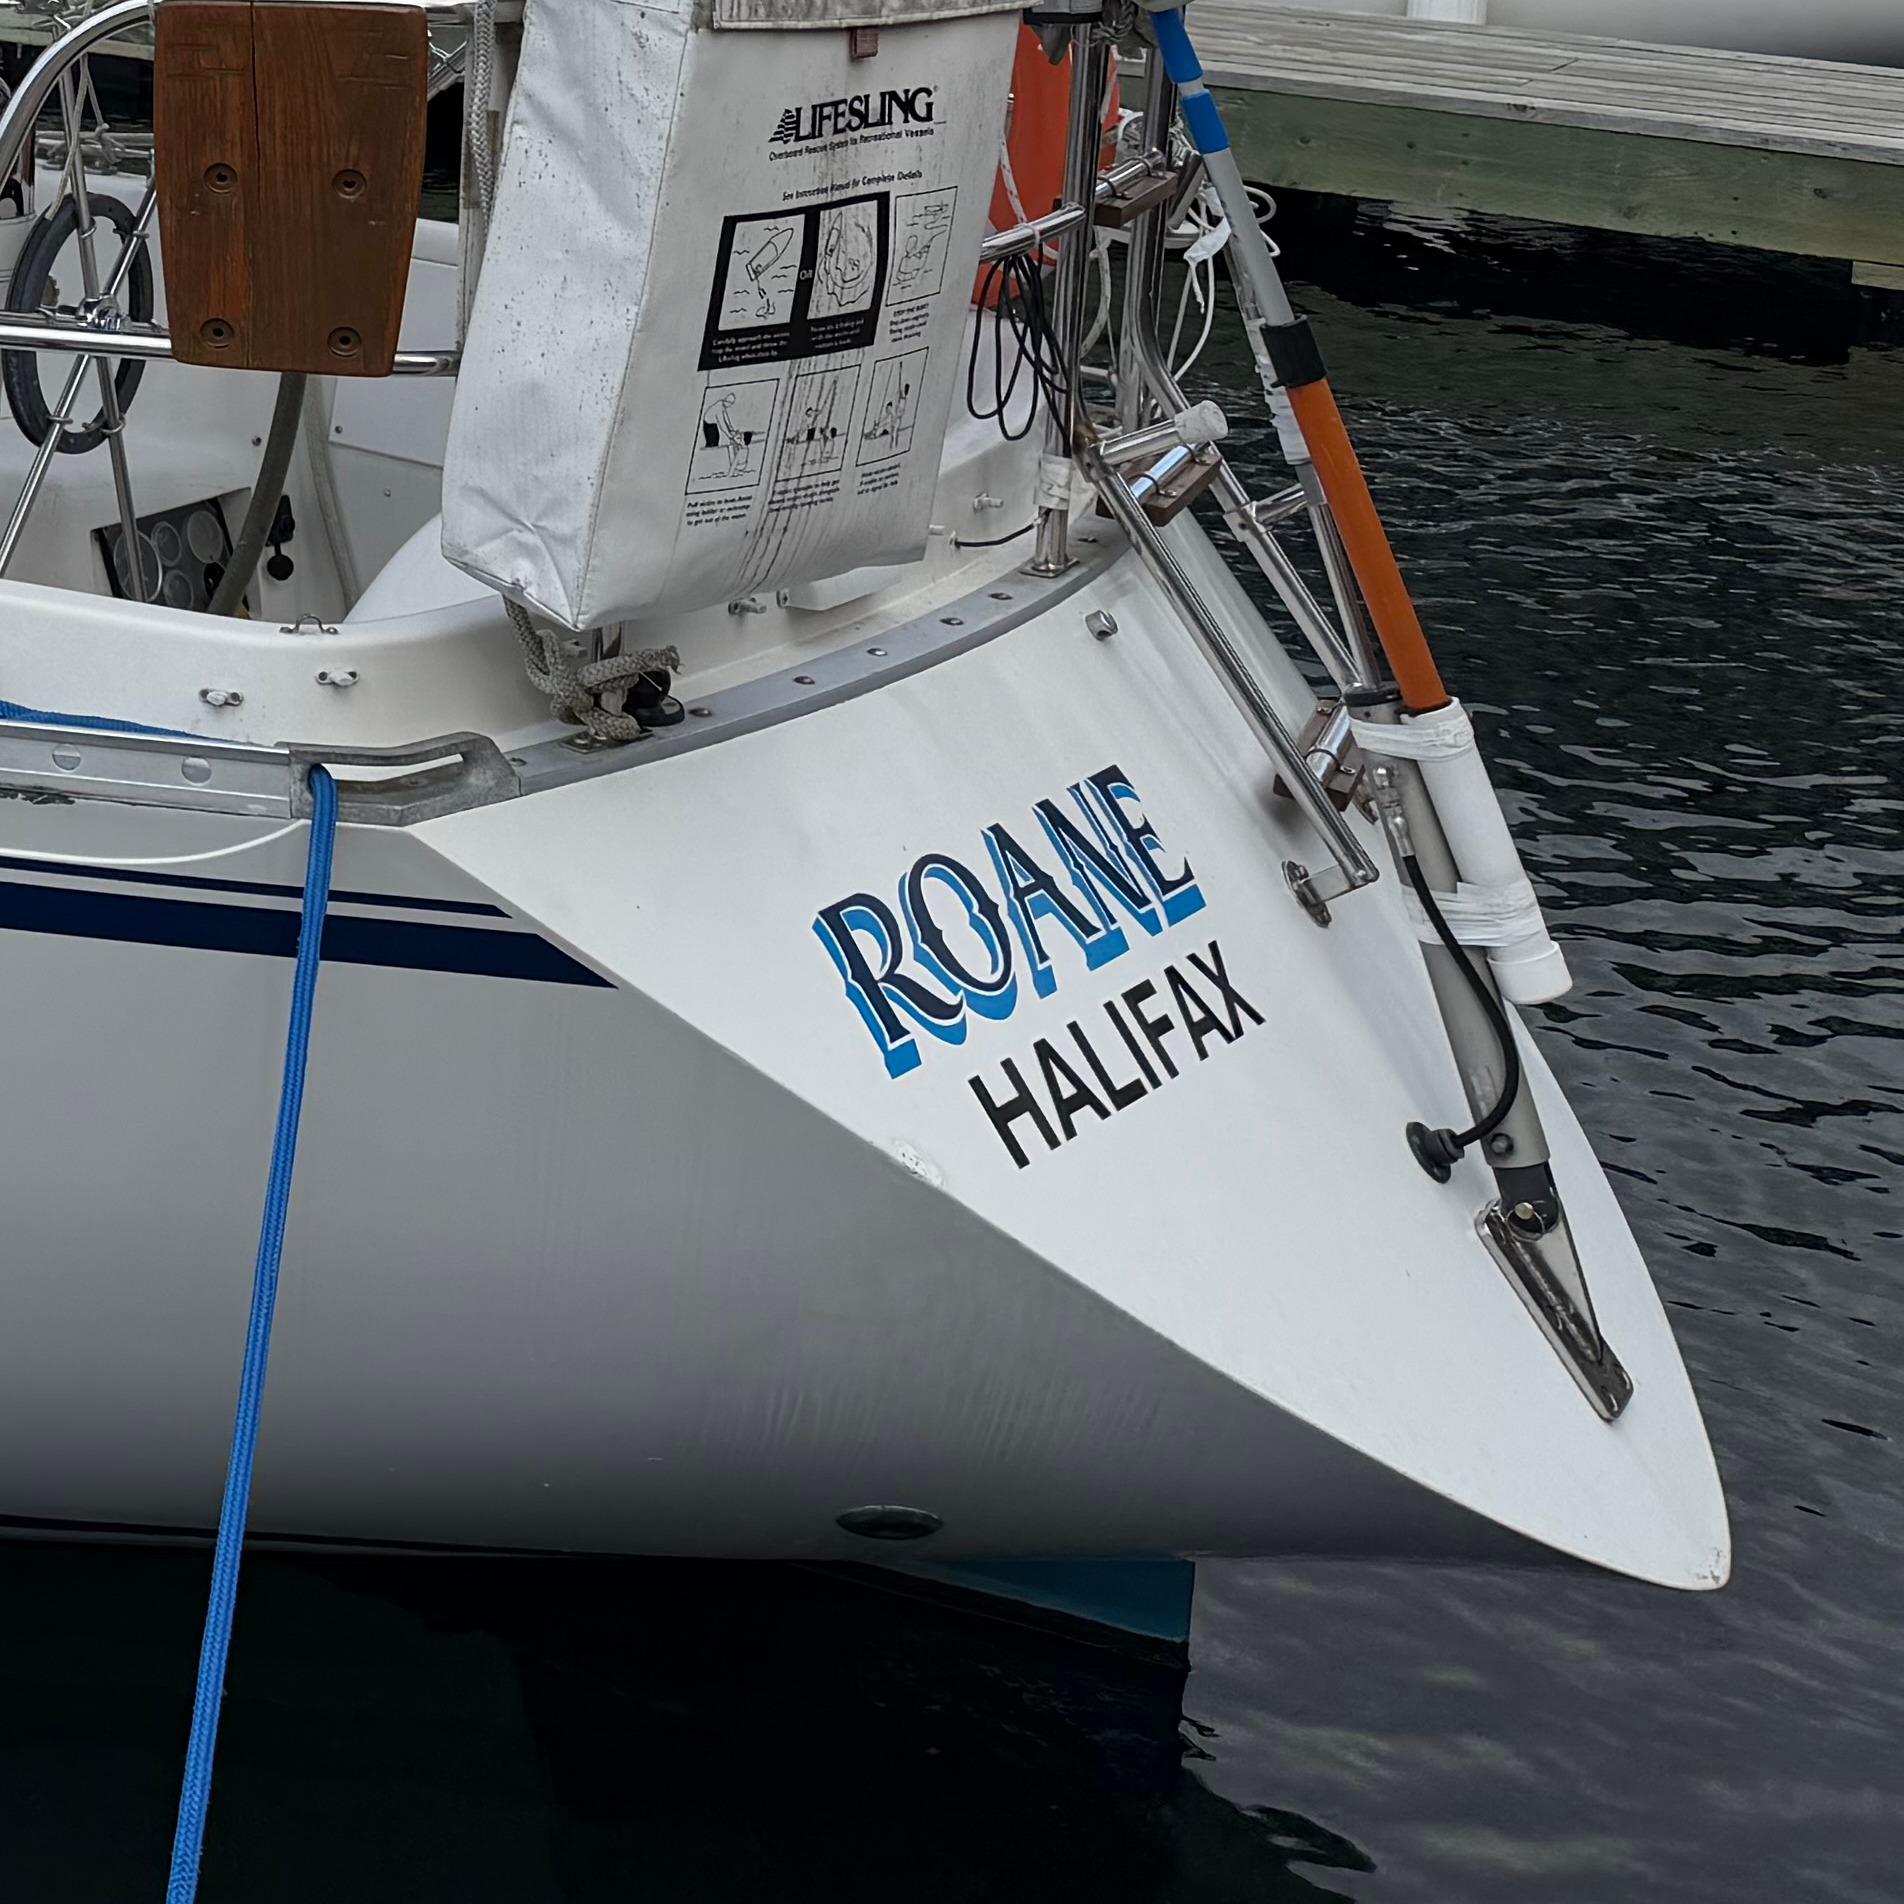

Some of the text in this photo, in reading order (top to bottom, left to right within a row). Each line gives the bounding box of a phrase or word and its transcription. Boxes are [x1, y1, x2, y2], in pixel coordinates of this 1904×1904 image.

[792, 87, 934, 142] LIFESLING
[812, 765, 1206, 1079] ROANE
[968, 940, 1266, 1169] HALIFAX
